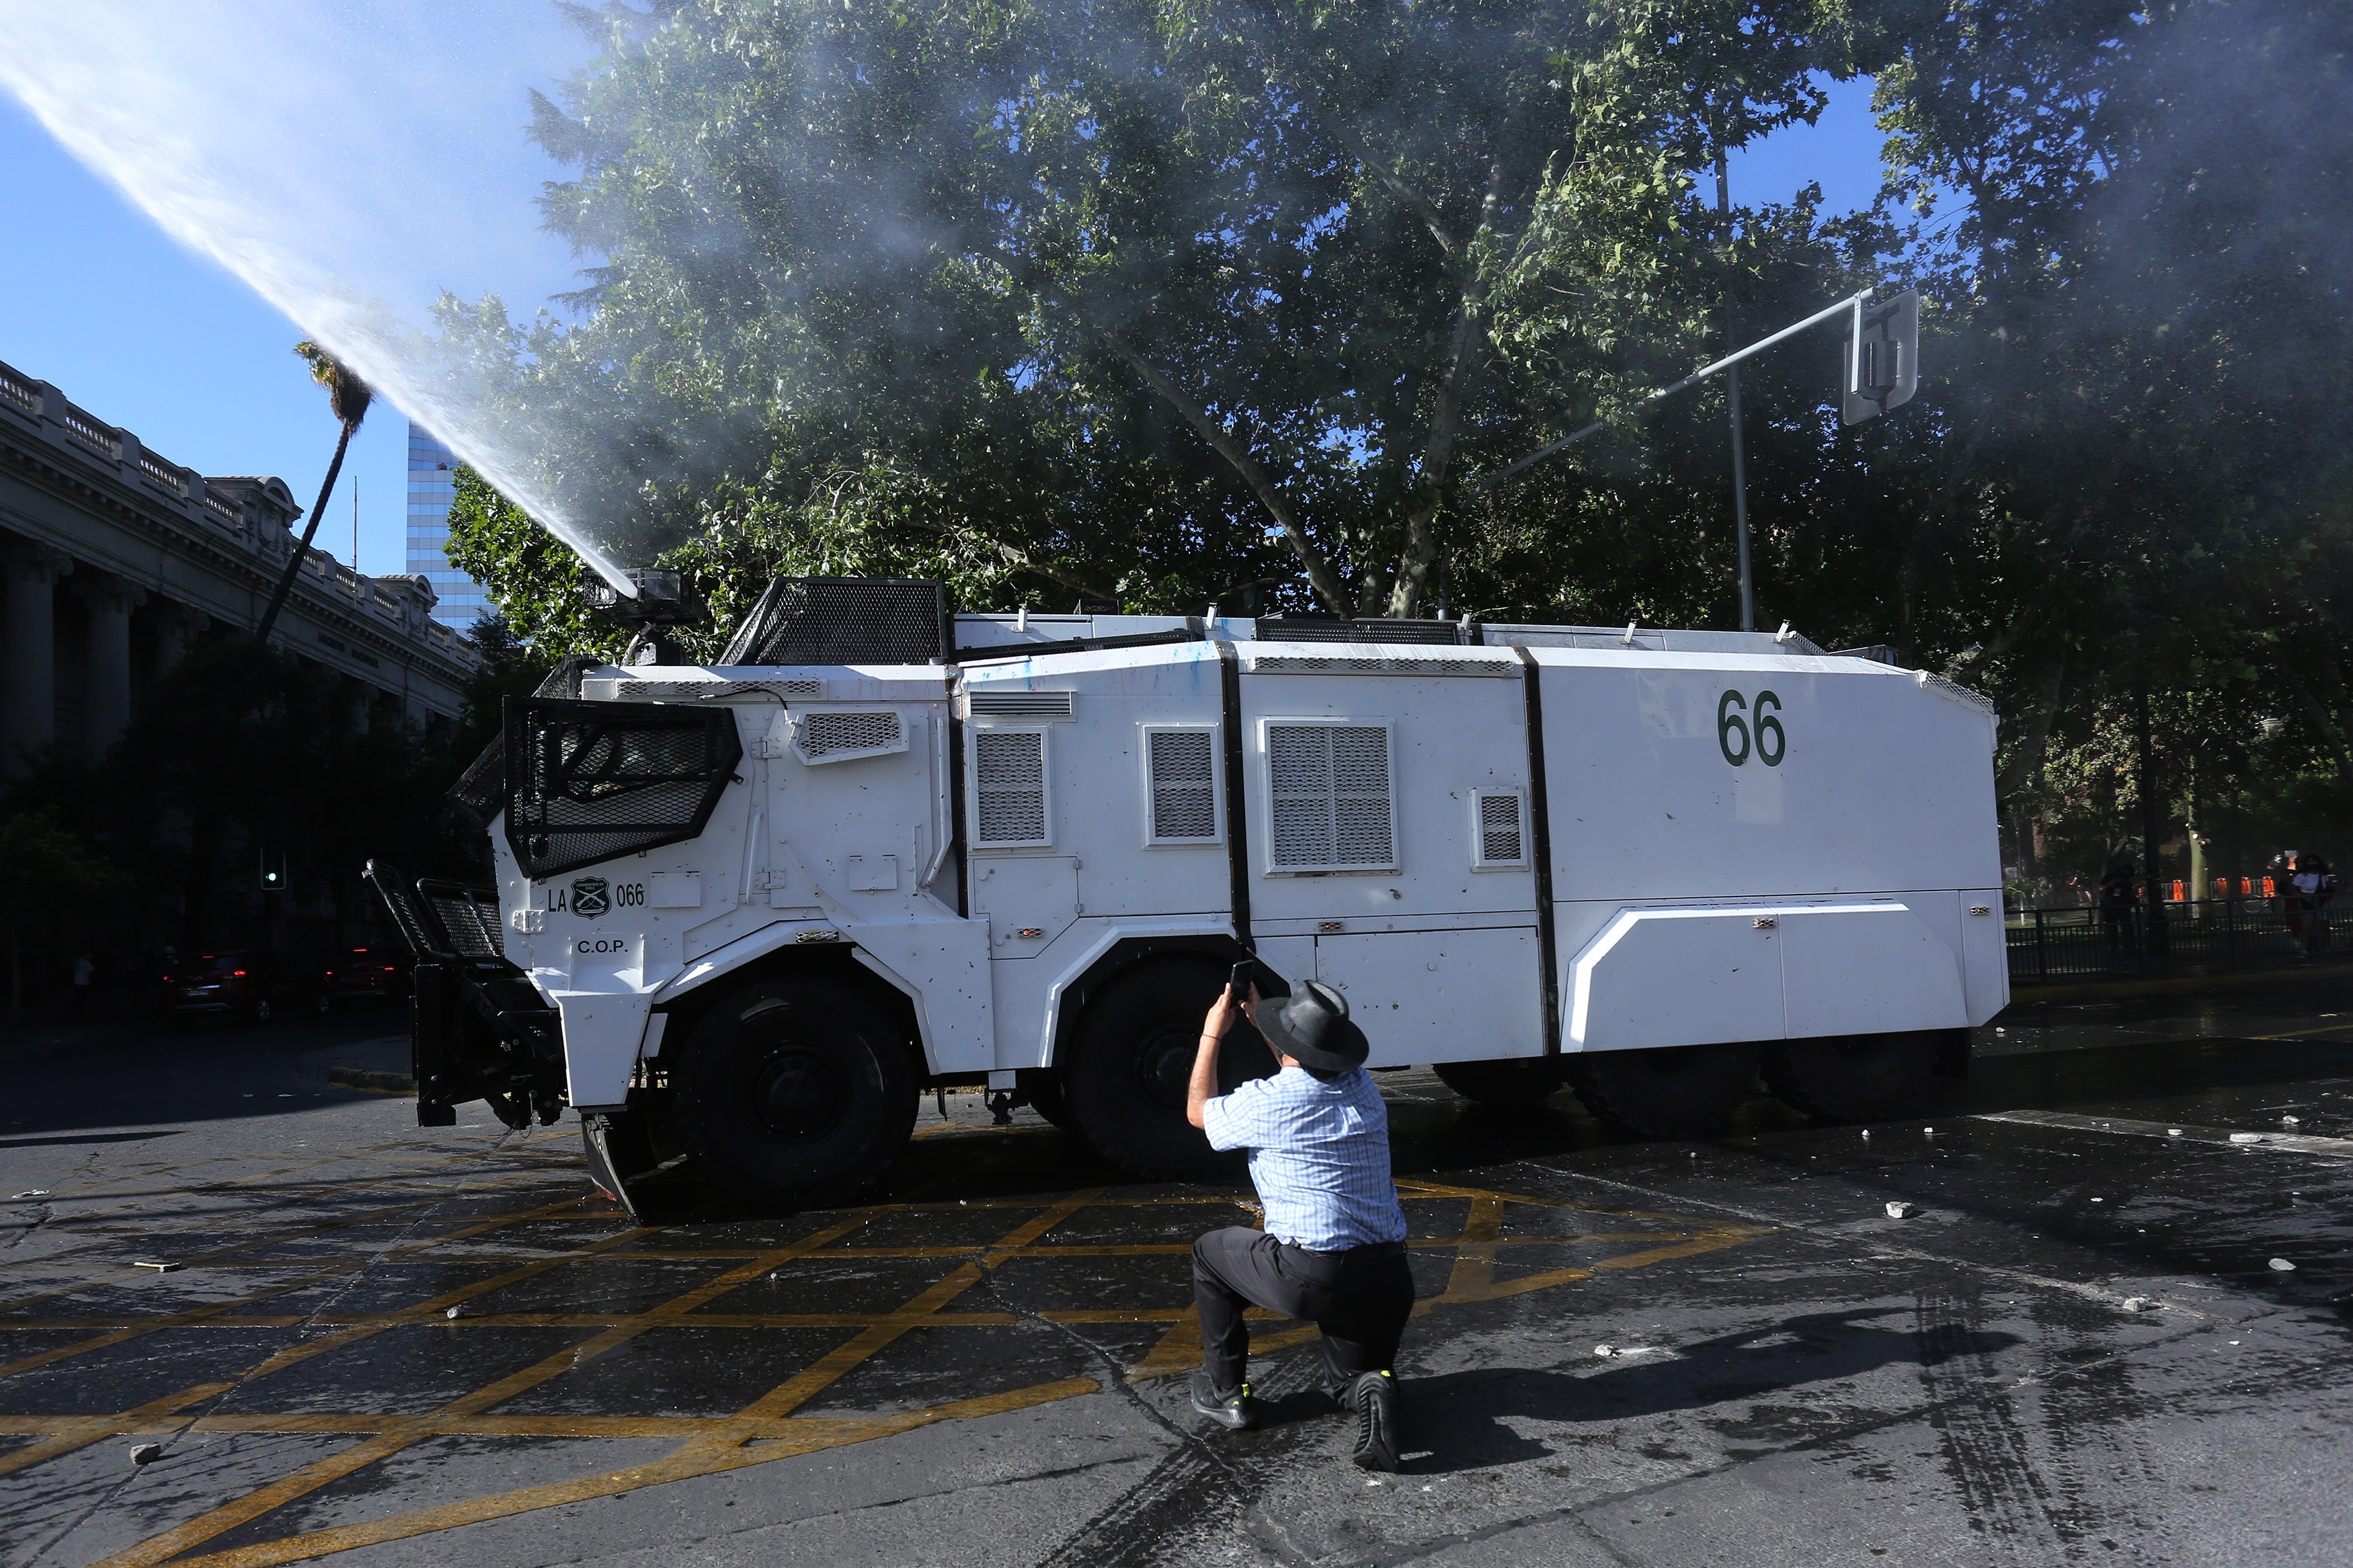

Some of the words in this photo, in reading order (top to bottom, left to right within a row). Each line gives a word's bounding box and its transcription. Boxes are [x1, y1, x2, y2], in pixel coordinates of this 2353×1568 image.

[1718, 690, 1786, 767] 66
[549, 889, 567, 912] LA
[616, 883, 644, 907] 066
[577, 940, 628, 953] C.O.P.
